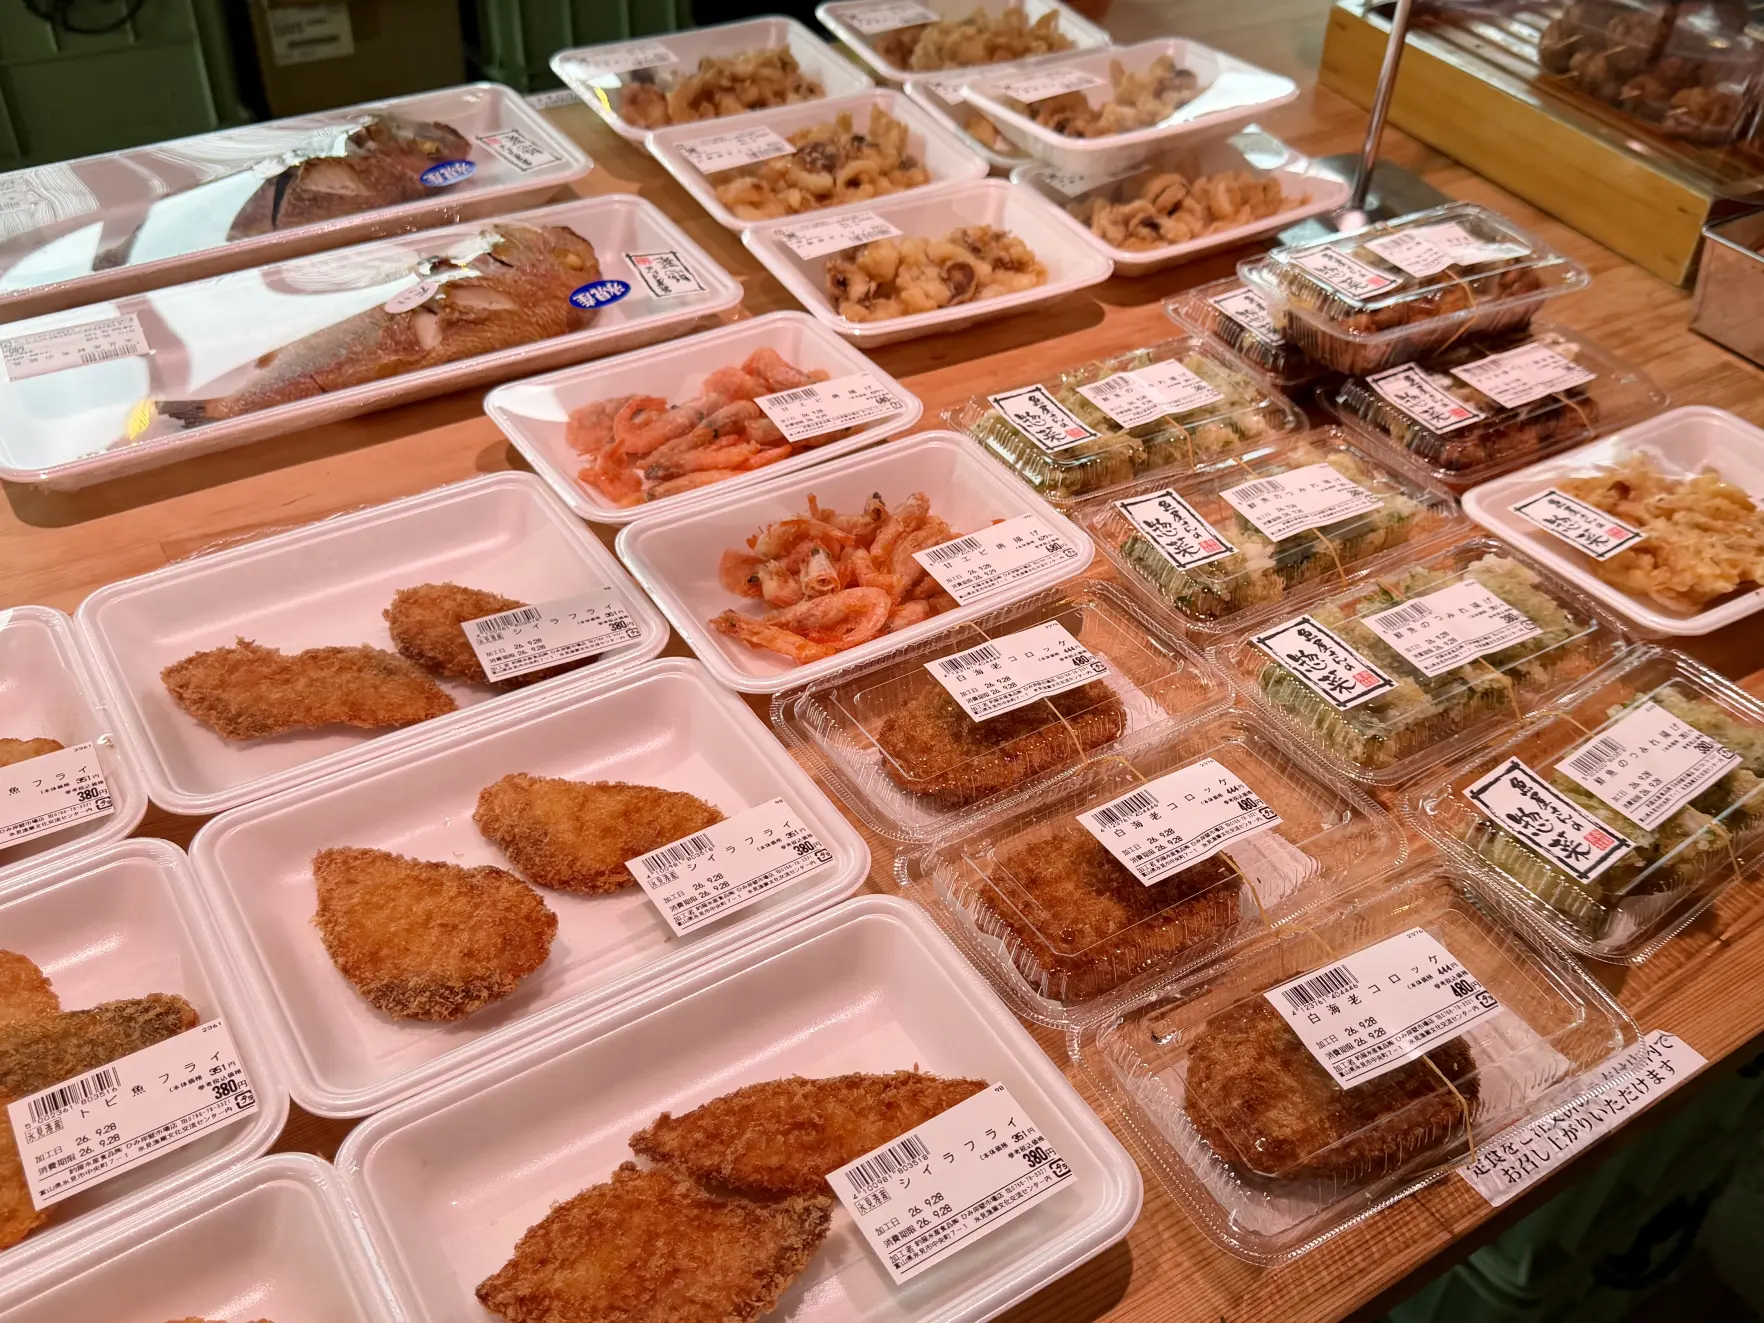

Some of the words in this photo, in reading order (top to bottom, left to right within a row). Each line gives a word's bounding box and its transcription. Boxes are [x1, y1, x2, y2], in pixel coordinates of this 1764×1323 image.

[573, 280, 627, 308] 氷見産
[1014, 411, 1067, 443] 惣菜
[1143, 517, 1201, 558] 惣菜
[513, 604, 611, 635] シイラフライ
[608, 620, 634, 632] 380円
[1393, 597, 1492, 639] 鮮魚のつみれ揚げ
[1297, 627, 1354, 671] 魚屋さんの
[956, 640, 1065, 682] 白海老コロッケ
[1072, 655, 1096, 666] 480円
[1286, 649, 1357, 694] 惣菜
[1594, 723, 1679, 785] 鮮魚のつみれ揚げ
[77, 787, 108, 802] 380円
[1237, 797, 1263, 811] 480円
[1508, 776, 1585, 832] 魚屋さんの
[1114, 779, 1227, 837] 白海老コロッケ
[1506, 806, 1593, 862] 惣菜
[687, 821, 790, 871] シイラフライ
[793, 841, 822, 856] 380円
[1121, 843, 1142, 856] 加工日
[1130, 849, 1156, 863] 消費期限
[663, 890, 685, 904] 加工日
[669, 896, 698, 912] 消費期限
[1308, 955, 1437, 1024] 白海老コロッケ
[1450, 979, 1481, 997] 480円
[1316, 1034, 1339, 1049] 加工日
[1326, 1043, 1355, 1060] 消費期限
[81, 1052, 219, 1118] トビ魚フライ
[212, 1079, 247, 1099] 380円
[37, 1104, 73, 1124] 002361
[1502, 1059, 1676, 1184] お召し上がりいただけます
[35, 1146, 63, 1164] 加工日
[39, 1153, 76, 1175] 消費期限
[900, 1117, 1016, 1189] シイラフライ
[1022, 1146, 1056, 1168] 380円
[862, 1174, 892, 1194] 100981
[875, 1217, 900, 1236] 加工日
[884, 1225, 916, 1248] 消費期限
